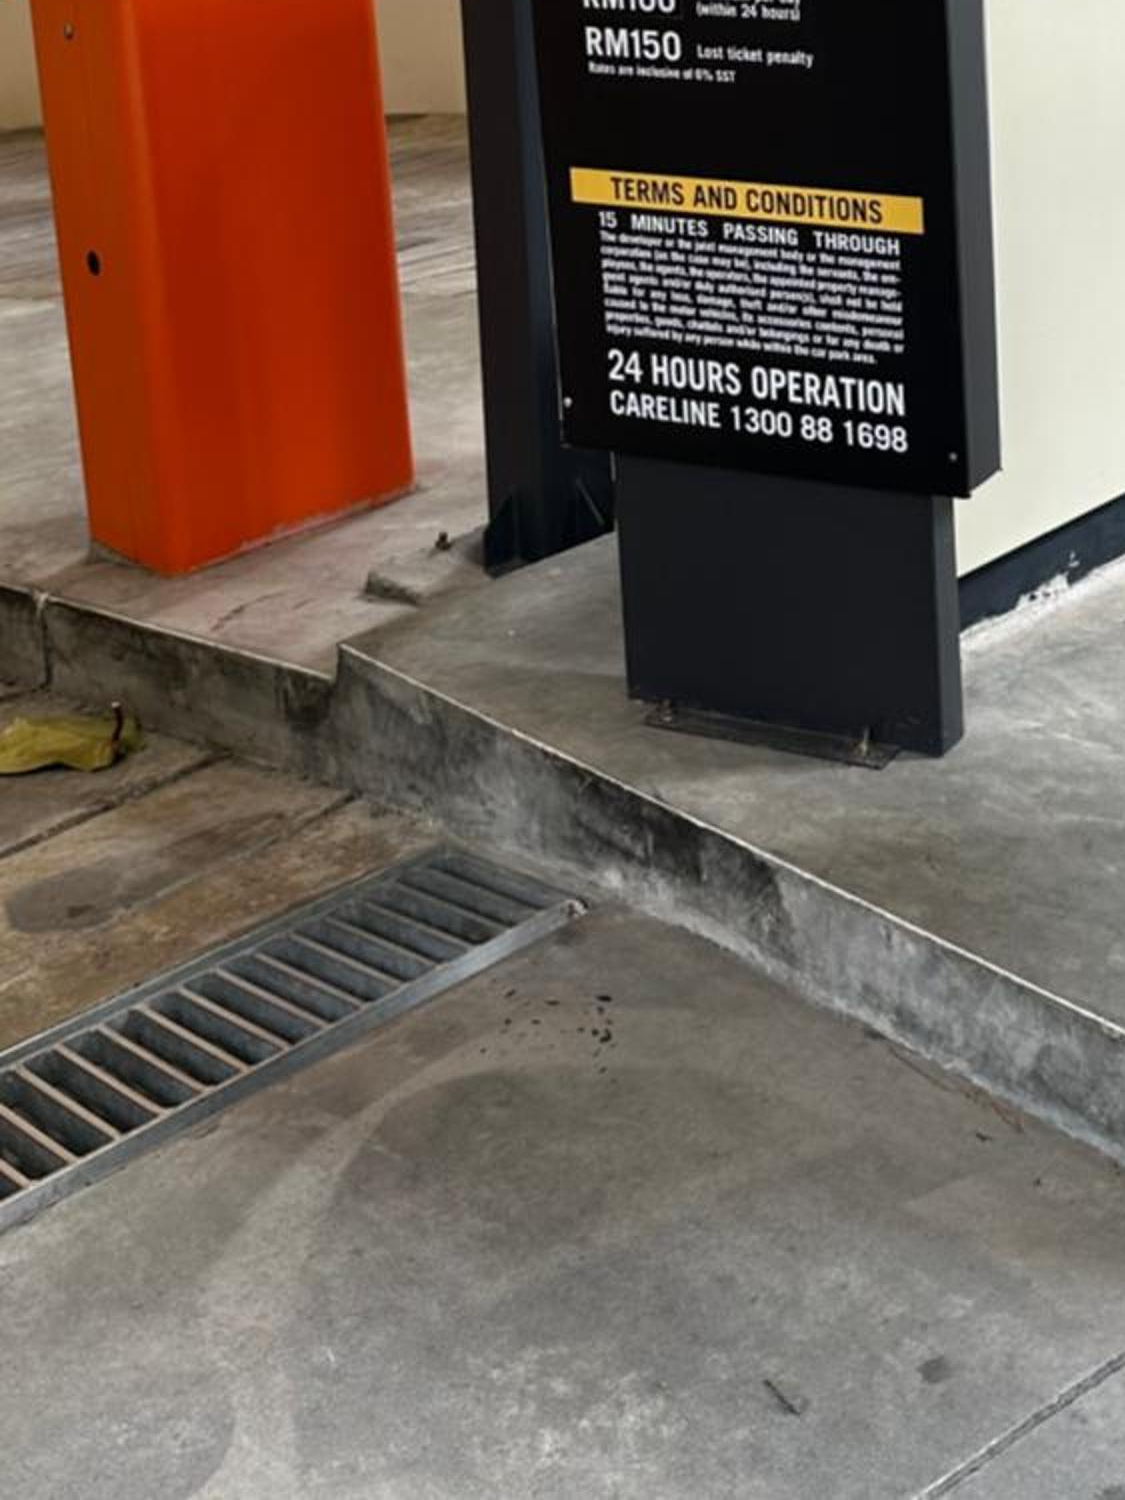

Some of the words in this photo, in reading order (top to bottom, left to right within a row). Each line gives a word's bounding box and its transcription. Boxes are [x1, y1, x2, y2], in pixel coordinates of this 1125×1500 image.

[740, 3, 757, 18] 24
[585, 26, 682, 62] RM150
[697, 44, 723, 60] Lost
[727, 46, 762, 62] ticket
[766, 50, 814, 69] penalty
[618, 66, 634, 76] are
[715, 69, 736, 83] SST
[610, 176, 684, 206] TERMS
[692, 185, 737, 211] AND
[745, 188, 883, 224] CONDITIONS
[598, 211, 618, 228] 15
[630, 213, 709, 237] MINUTES
[723, 222, 798, 246] PASSING
[812, 230, 900, 256] THROUGH
[608, 349, 643, 383] 24
[651, 352, 741, 396] HOURS
[751, 365, 906, 417] OPERATION
[609, 389, 721, 429] CARELINE
[731, 406, 793, 438] 1300
[801, 415, 833, 444] 88
[844, 421, 908, 452] 1698
